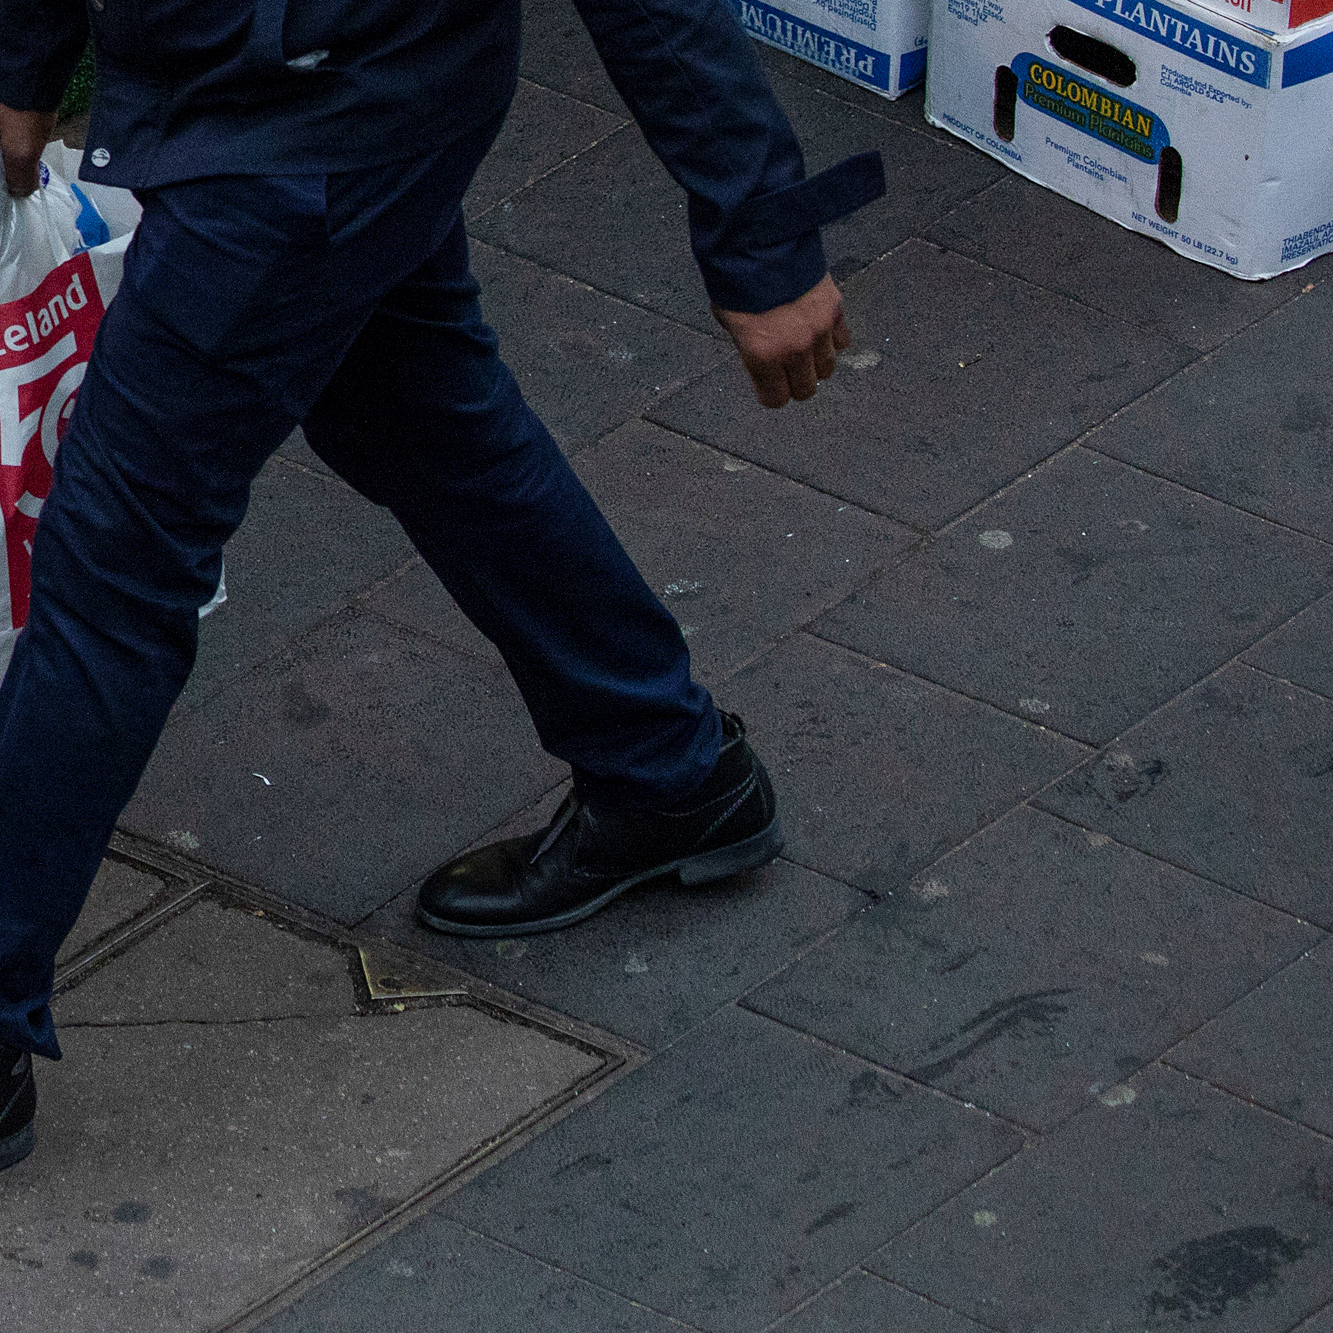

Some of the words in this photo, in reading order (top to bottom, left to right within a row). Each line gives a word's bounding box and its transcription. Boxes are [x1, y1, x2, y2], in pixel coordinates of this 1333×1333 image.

[829, 7, 877, 31] Distribuited
[836, 0, 878, 23] Tropifruit
[948, 4, 979, 26] England
[971, 5, 989, 22] 1NZ
[739, 0, 876, 78] PREMIUM
[1160, 64, 1192, 86] Produced
[1208, 80, 1240, 106] Exported
[1160, 78, 1192, 97] Colombia
[1172, 75, 1205, 97] ARGOLD
[1028, 63, 1153, 138] COLOMBIAN
[1023, 81, 1087, 127] Premium
[1087, 106, 1155, 160] Plantains
[942, 112, 975, 138] PRODUCT
[985, 136, 1023, 163] COLOMBIA
[1044, 136, 1082, 160] Premium
[1081, 151, 1129, 184] Colombian
[1066, 155, 1105, 183] Plantains
[1131, 211, 1147, 225] NET
[1147, 219, 1180, 241] WEIGHT
[1180, 234, 1192, 245] 50
[1192, 239, 1203, 250] LB
[1203, 242, 1224, 258] (22.7
[1224, 252, 1239, 266] kg)
[1282, 234, 1321, 255] IMAZALIL
